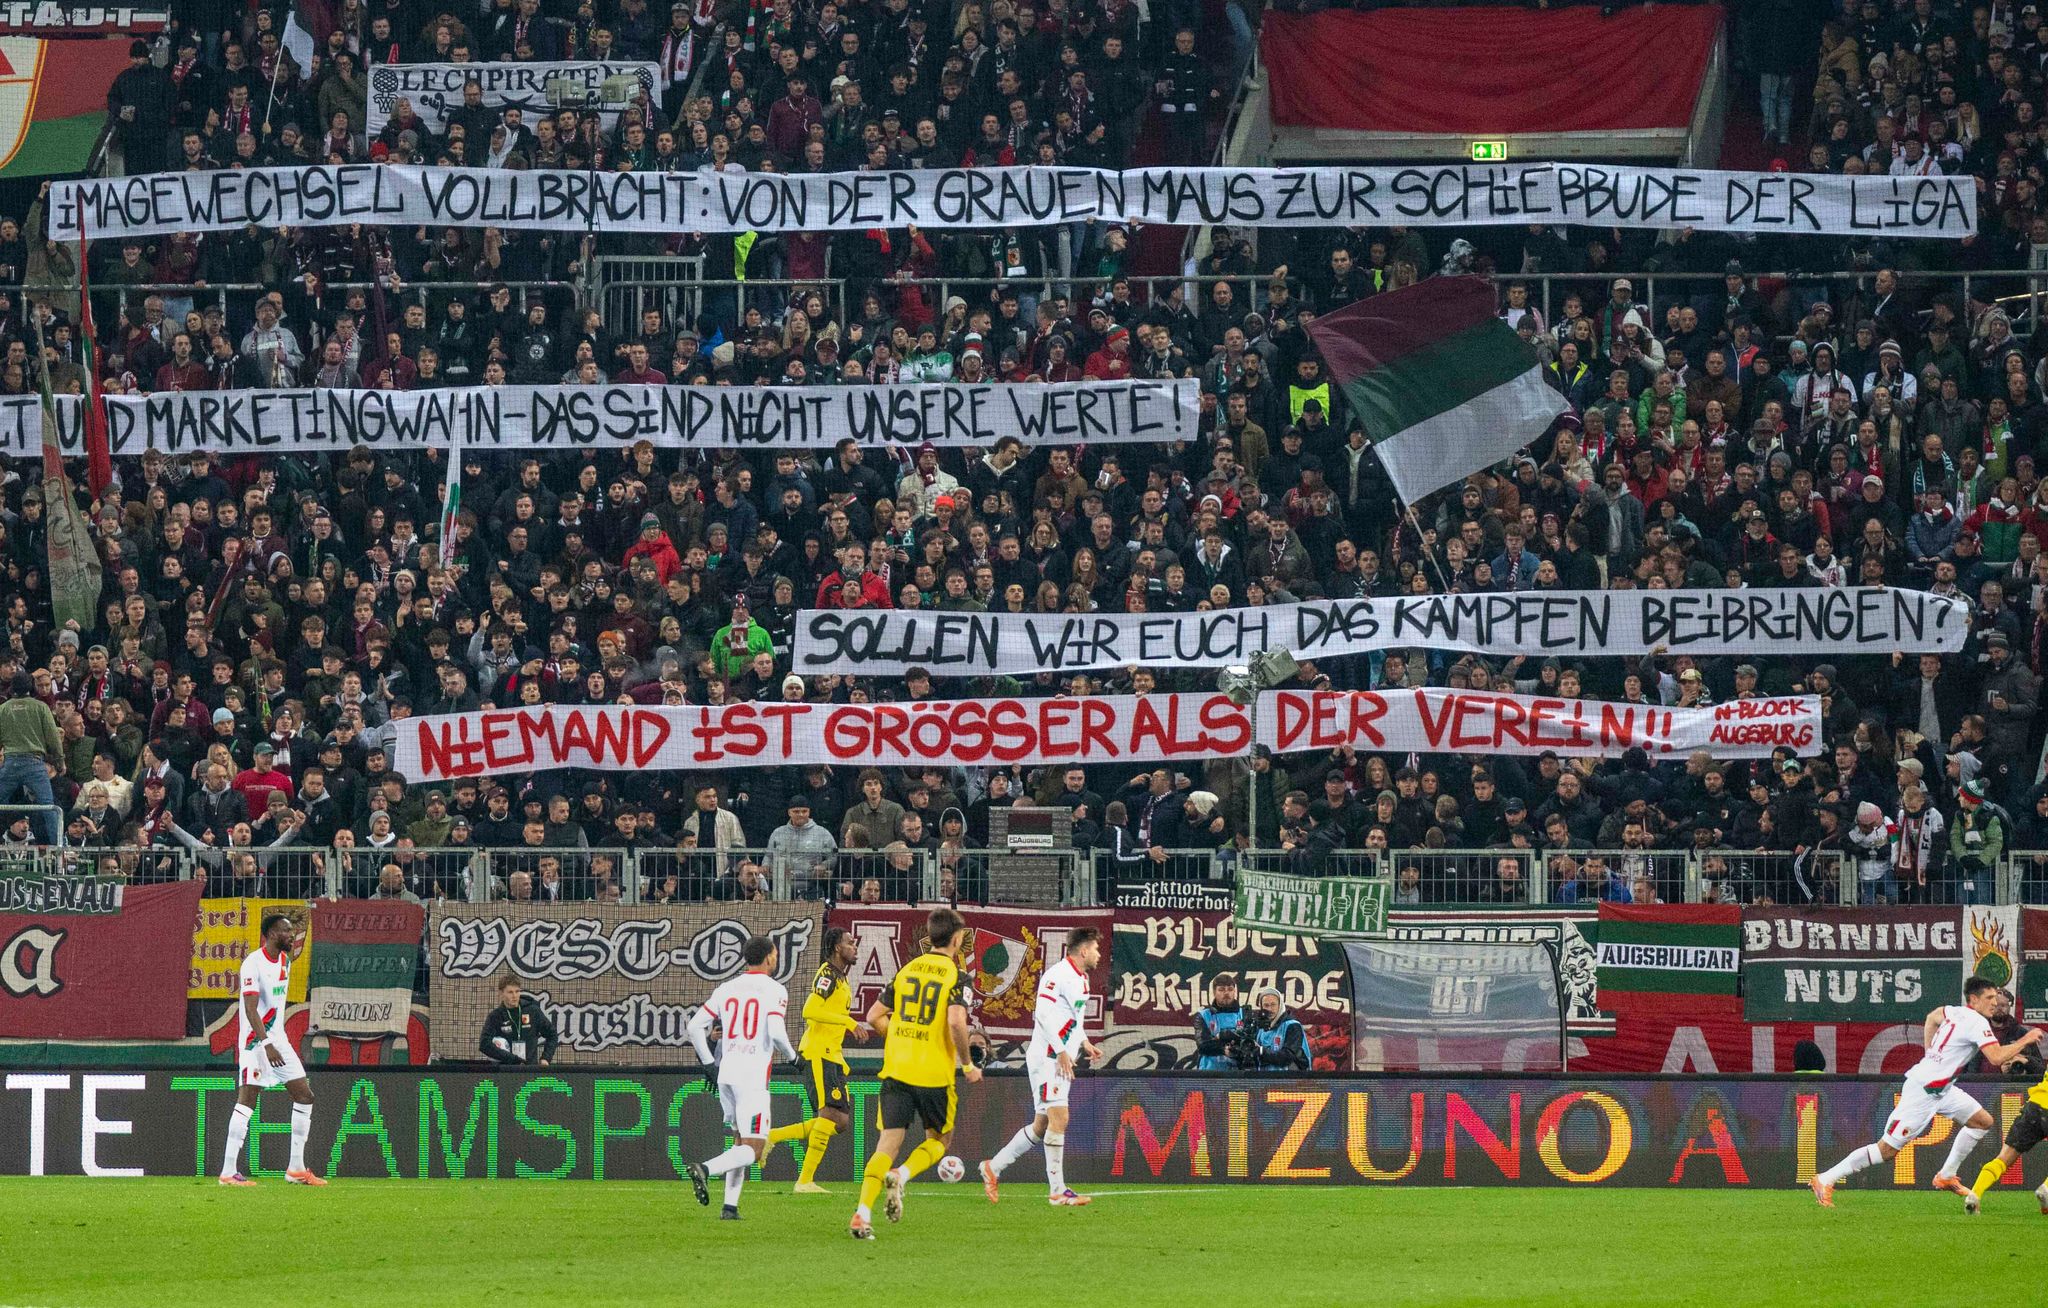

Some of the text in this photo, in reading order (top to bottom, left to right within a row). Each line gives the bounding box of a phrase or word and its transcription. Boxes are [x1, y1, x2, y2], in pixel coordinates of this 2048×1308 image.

[721, 176, 806, 227] VON
[828, 173, 918, 223] DER
[934, 168, 1125, 223] GRAUEN
[1143, 169, 1264, 222] MAUS
[1275, 171, 1381, 219] ZUR
[1725, 178, 1820, 230] DER
[0, 399, 38, 449] T
[847, 387, 995, 443] UNSERE
[804, 613, 999, 668] SOLLEN
[1140, 611, 1268, 662] EUCH
[1297, 602, 1380, 650] DAS
[1393, 595, 1610, 650] KÄMPFEN
[824, 701, 1119, 761] GRÖSSER
[1130, 692, 1252, 757] ALS
[1277, 691, 1389, 751] DER
[1709, 723, 1814, 749] AUGSBURG
[1143, 881, 1203, 895] sektion
[1242, 872, 1321, 894] DURCHHALTEN
[323, 913, 408, 931] WEITER
[1243, 886, 1323, 927] TETE!
[1744, 919, 1957, 951] BURNING
[1601, 945, 1734, 970] AUGSBULGAR
[900, 976, 944, 1026] 28
[1784, 969, 1923, 1004] NUTS
[320, 1001, 393, 1021] SIMON!
[725, 997, 760, 1040] 20
[6, 1074, 145, 1177] TE
[1111, 1091, 1632, 1183] MIZUNO
